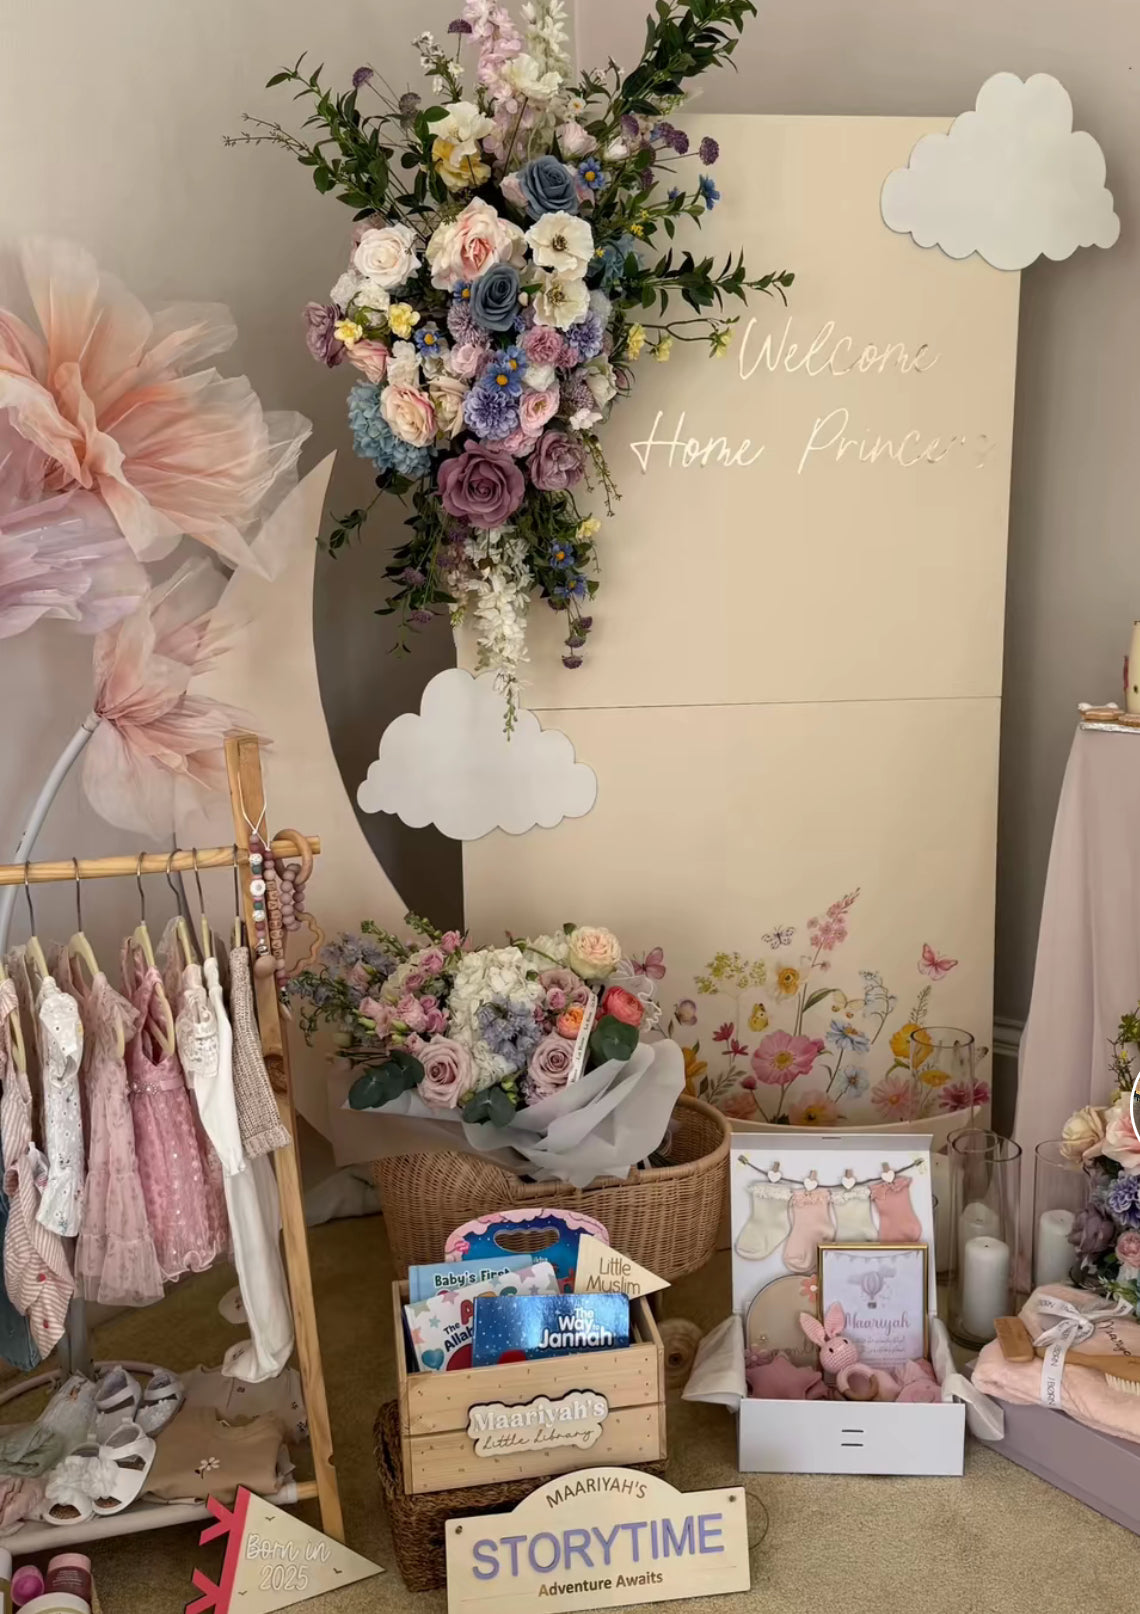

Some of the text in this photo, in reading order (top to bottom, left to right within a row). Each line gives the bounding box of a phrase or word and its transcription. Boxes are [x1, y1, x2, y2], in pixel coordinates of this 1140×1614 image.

[739, 316, 941, 380] Welcome
[630, 408, 997, 475] Home Prince
[600, 1257, 631, 1276] Little
[435, 1271, 476, 1287] Baby's
[586, 1275, 641, 1295] Muslim
[558, 1315, 593, 1333] Way
[574, 1307, 594, 1319] The
[443, 1322, 460, 1335] The
[538, 1326, 613, 1348] Jannah
[472, 1400, 606, 1433] Maariyah's
[482, 1429, 595, 1450] Little Library
[546, 1477, 648, 1508] MAARIYAH'S
[246, 1533, 331, 1561] Born in
[472, 1513, 725, 1580] STORYTIME
[259, 1563, 309, 1591] 2025
[538, 1571, 664, 1598] Adventure Awaits
